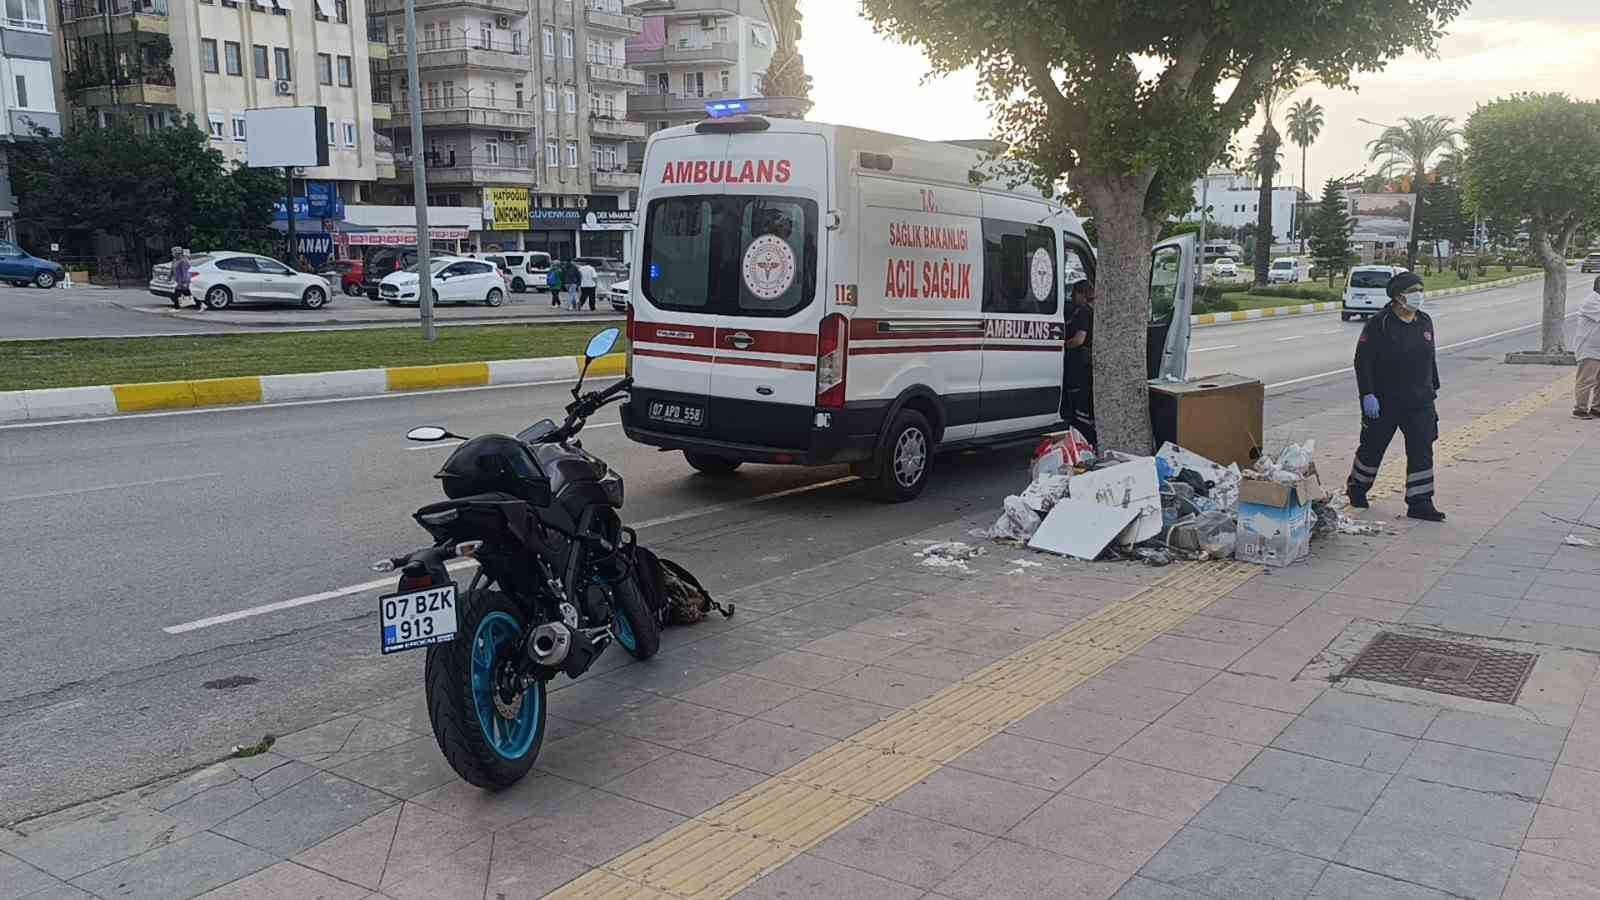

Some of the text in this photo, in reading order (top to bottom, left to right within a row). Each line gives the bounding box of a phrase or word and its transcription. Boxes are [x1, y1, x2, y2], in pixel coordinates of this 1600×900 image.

[661, 159, 791, 184] AMBULANS
[889, 220, 922, 248] SAĞLIK
[885, 257, 972, 299] ACİL SAĞLIK
[985, 319, 1051, 340] AMBULANS
[652, 402, 663, 416] 07
[684, 407, 701, 421] 558
[385, 590, 452, 620] 07 BZK
[401, 616, 434, 639] 913
